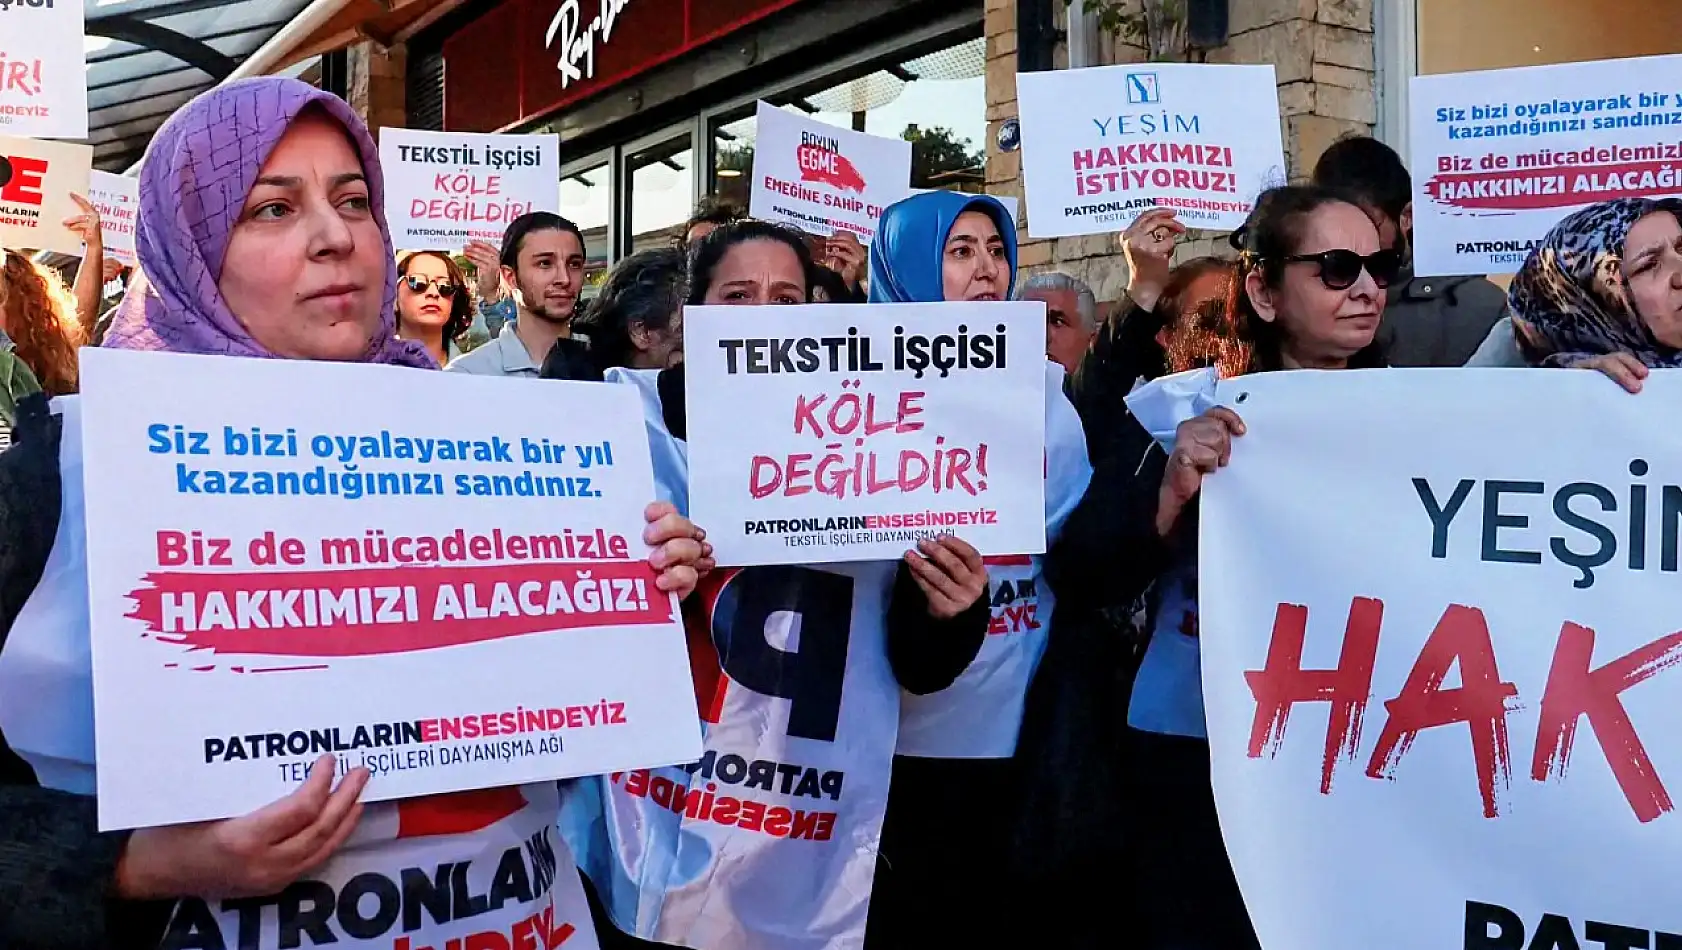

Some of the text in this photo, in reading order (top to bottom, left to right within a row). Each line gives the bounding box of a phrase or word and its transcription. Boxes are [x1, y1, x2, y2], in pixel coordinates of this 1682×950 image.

[1436, 108, 1466, 123] Siz
[1471, 103, 1508, 121] bizi
[1514, 95, 1632, 121] oyalayarak
[1639, 92, 1669, 108] bir
[1093, 110, 1199, 137] YEŞİM
[1448, 117, 1586, 140] kazandığınızı
[398, 143, 541, 170] TEKSTİL İŞÇİSİ
[801, 131, 839, 155] BOYUN
[1073, 143, 1233, 171] HAKKIMIZI
[1437, 156, 1472, 173] Biz
[1480, 152, 1508, 169] de
[434, 168, 500, 195] KÖLE
[764, 176, 820, 204] EMEĞİNE
[823, 193, 864, 214] SAHİP
[1075, 168, 1236, 197] İSTİYORUZ!
[1438, 175, 1565, 200] HAKKIMIZI
[719, 323, 1006, 379] TEKSTİL İŞÇİSİ
[793, 379, 926, 439] KÖLE
[147, 424, 613, 469] Siz bizi oyalayarak bir yıl
[177, 463, 603, 500] kazandığınızı sandınız.
[749, 436, 989, 500] DEĞİLDİR!
[745, 507, 998, 535] PATRONLARINENSESİNDEYİZ
[157, 529, 629, 567] Biz de mücadelemizle
[784, 532, 827, 547] TEKSTİL
[829, 527, 873, 546] İŞÇİLERİ
[161, 569, 650, 632] HAKKIMIZI ALACAĞIZ!
[204, 698, 627, 764] PATRONLARINENSESİNDEYİZ
[440, 740, 535, 766] DAYANIŞMA
[540, 736, 565, 755] AĞI
